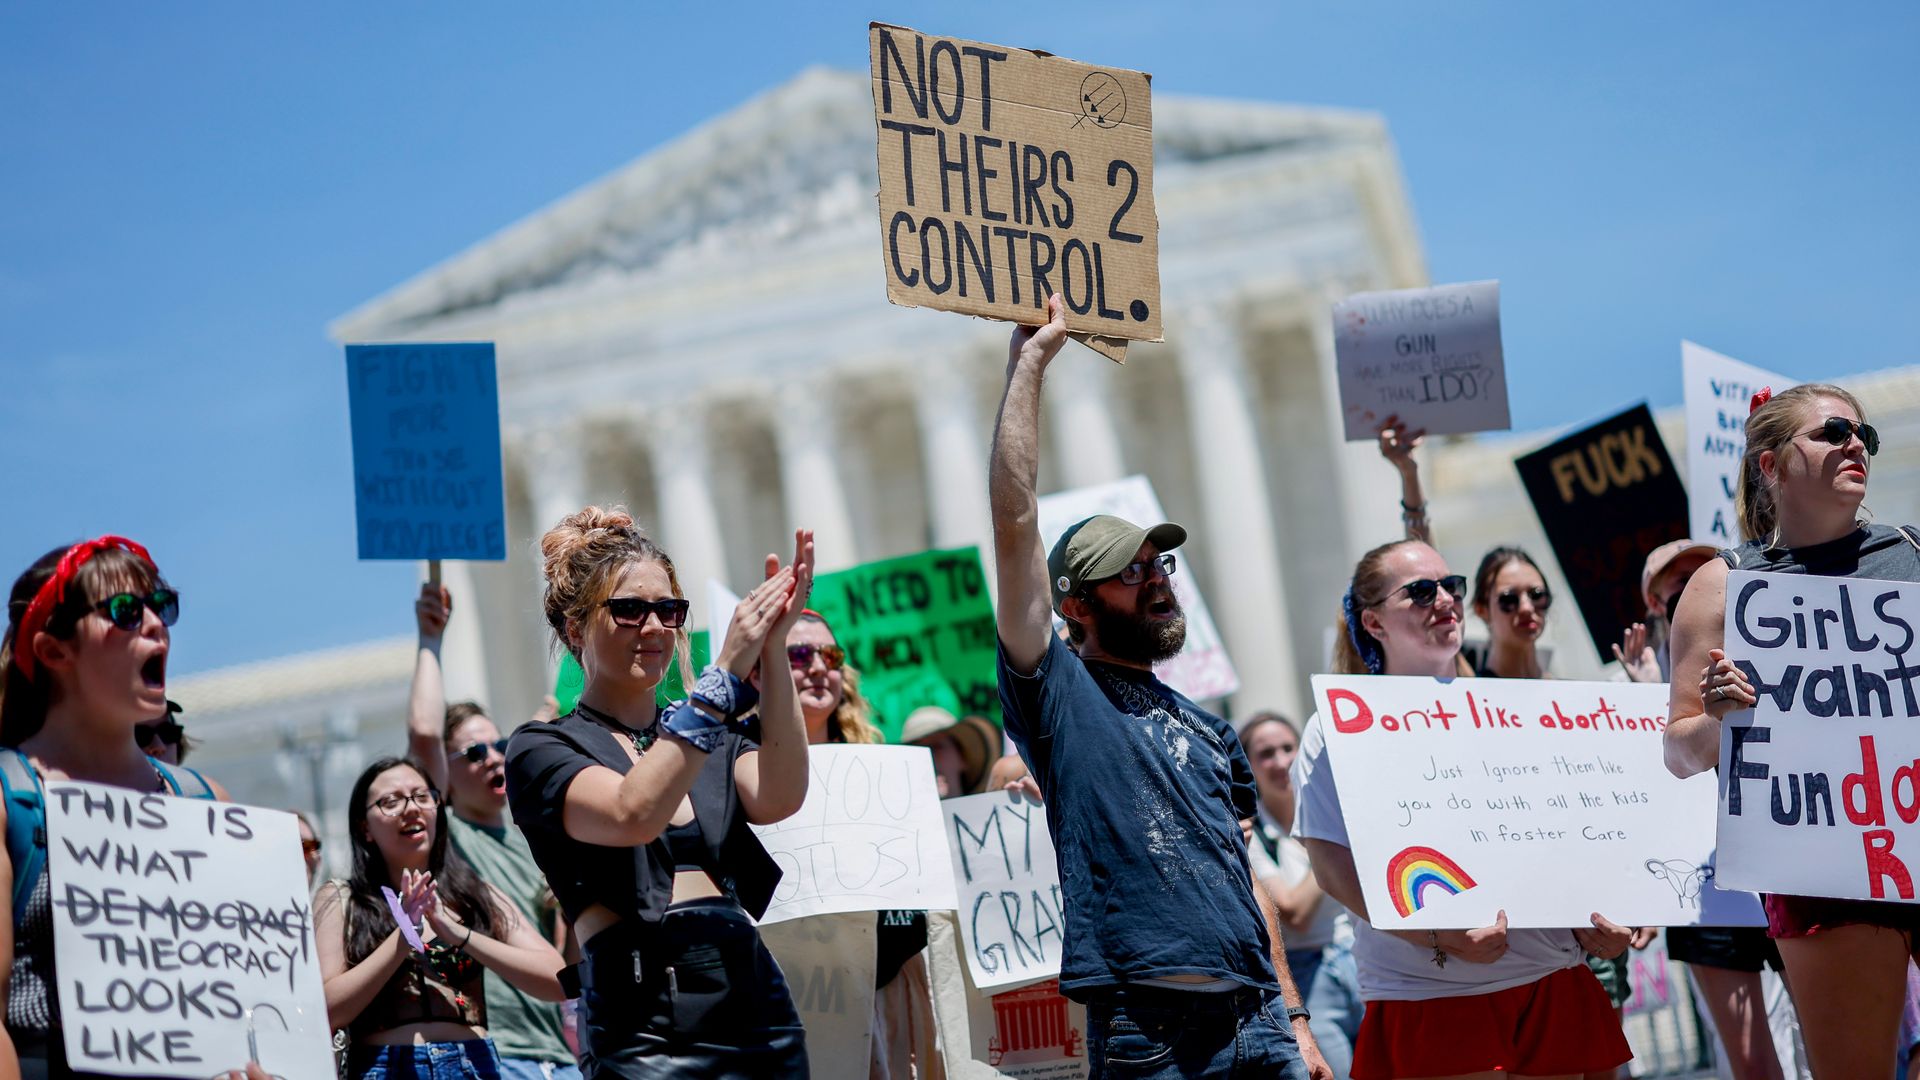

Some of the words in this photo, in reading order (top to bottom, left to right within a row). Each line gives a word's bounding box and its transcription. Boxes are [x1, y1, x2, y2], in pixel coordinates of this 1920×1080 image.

[879, 27, 1007, 131] NOT
[881, 120, 1074, 229] THEIRS
[1107, 160, 1144, 243] 2
[889, 211, 1149, 322] CONTROL.
[1395, 333, 1437, 357] GUN
[357, 349, 493, 396] FIGHT
[388, 401, 449, 441] FOR
[1551, 425, 1663, 504] FUCK
[358, 472, 487, 510] WITHOUT
[844, 569, 930, 625] NEED
[935, 555, 982, 604] TO
[1326, 689, 1457, 733] Don't
[1466, 691, 1524, 729] like
[1539, 697, 1667, 732] abortions
[1423, 755, 1463, 781] Just
[1482, 760, 1540, 783] Ignore
[1551, 756, 1595, 776] them
[1597, 756, 1624, 776] like
[50, 787, 168, 829] THIS
[207, 806, 254, 840] IS
[810, 752, 911, 843] YOU
[1398, 800, 1432, 827] you
[1447, 792, 1472, 809] do
[1486, 795, 1532, 811] with
[1546, 794, 1568, 809] all
[1578, 792, 1604, 808] the
[952, 804, 1036, 885] MY
[1498, 824, 1567, 841] foster
[1582, 825, 1627, 841] Care
[61, 836, 208, 883] WHAT
[771, 829, 922, 903] OTUS!
[82, 933, 298, 993] THEOCRACY
[75, 978, 243, 1020] LOOKS
[82, 1025, 203, 1065] LIKE
[1068, 1061, 1081, 1069] and
